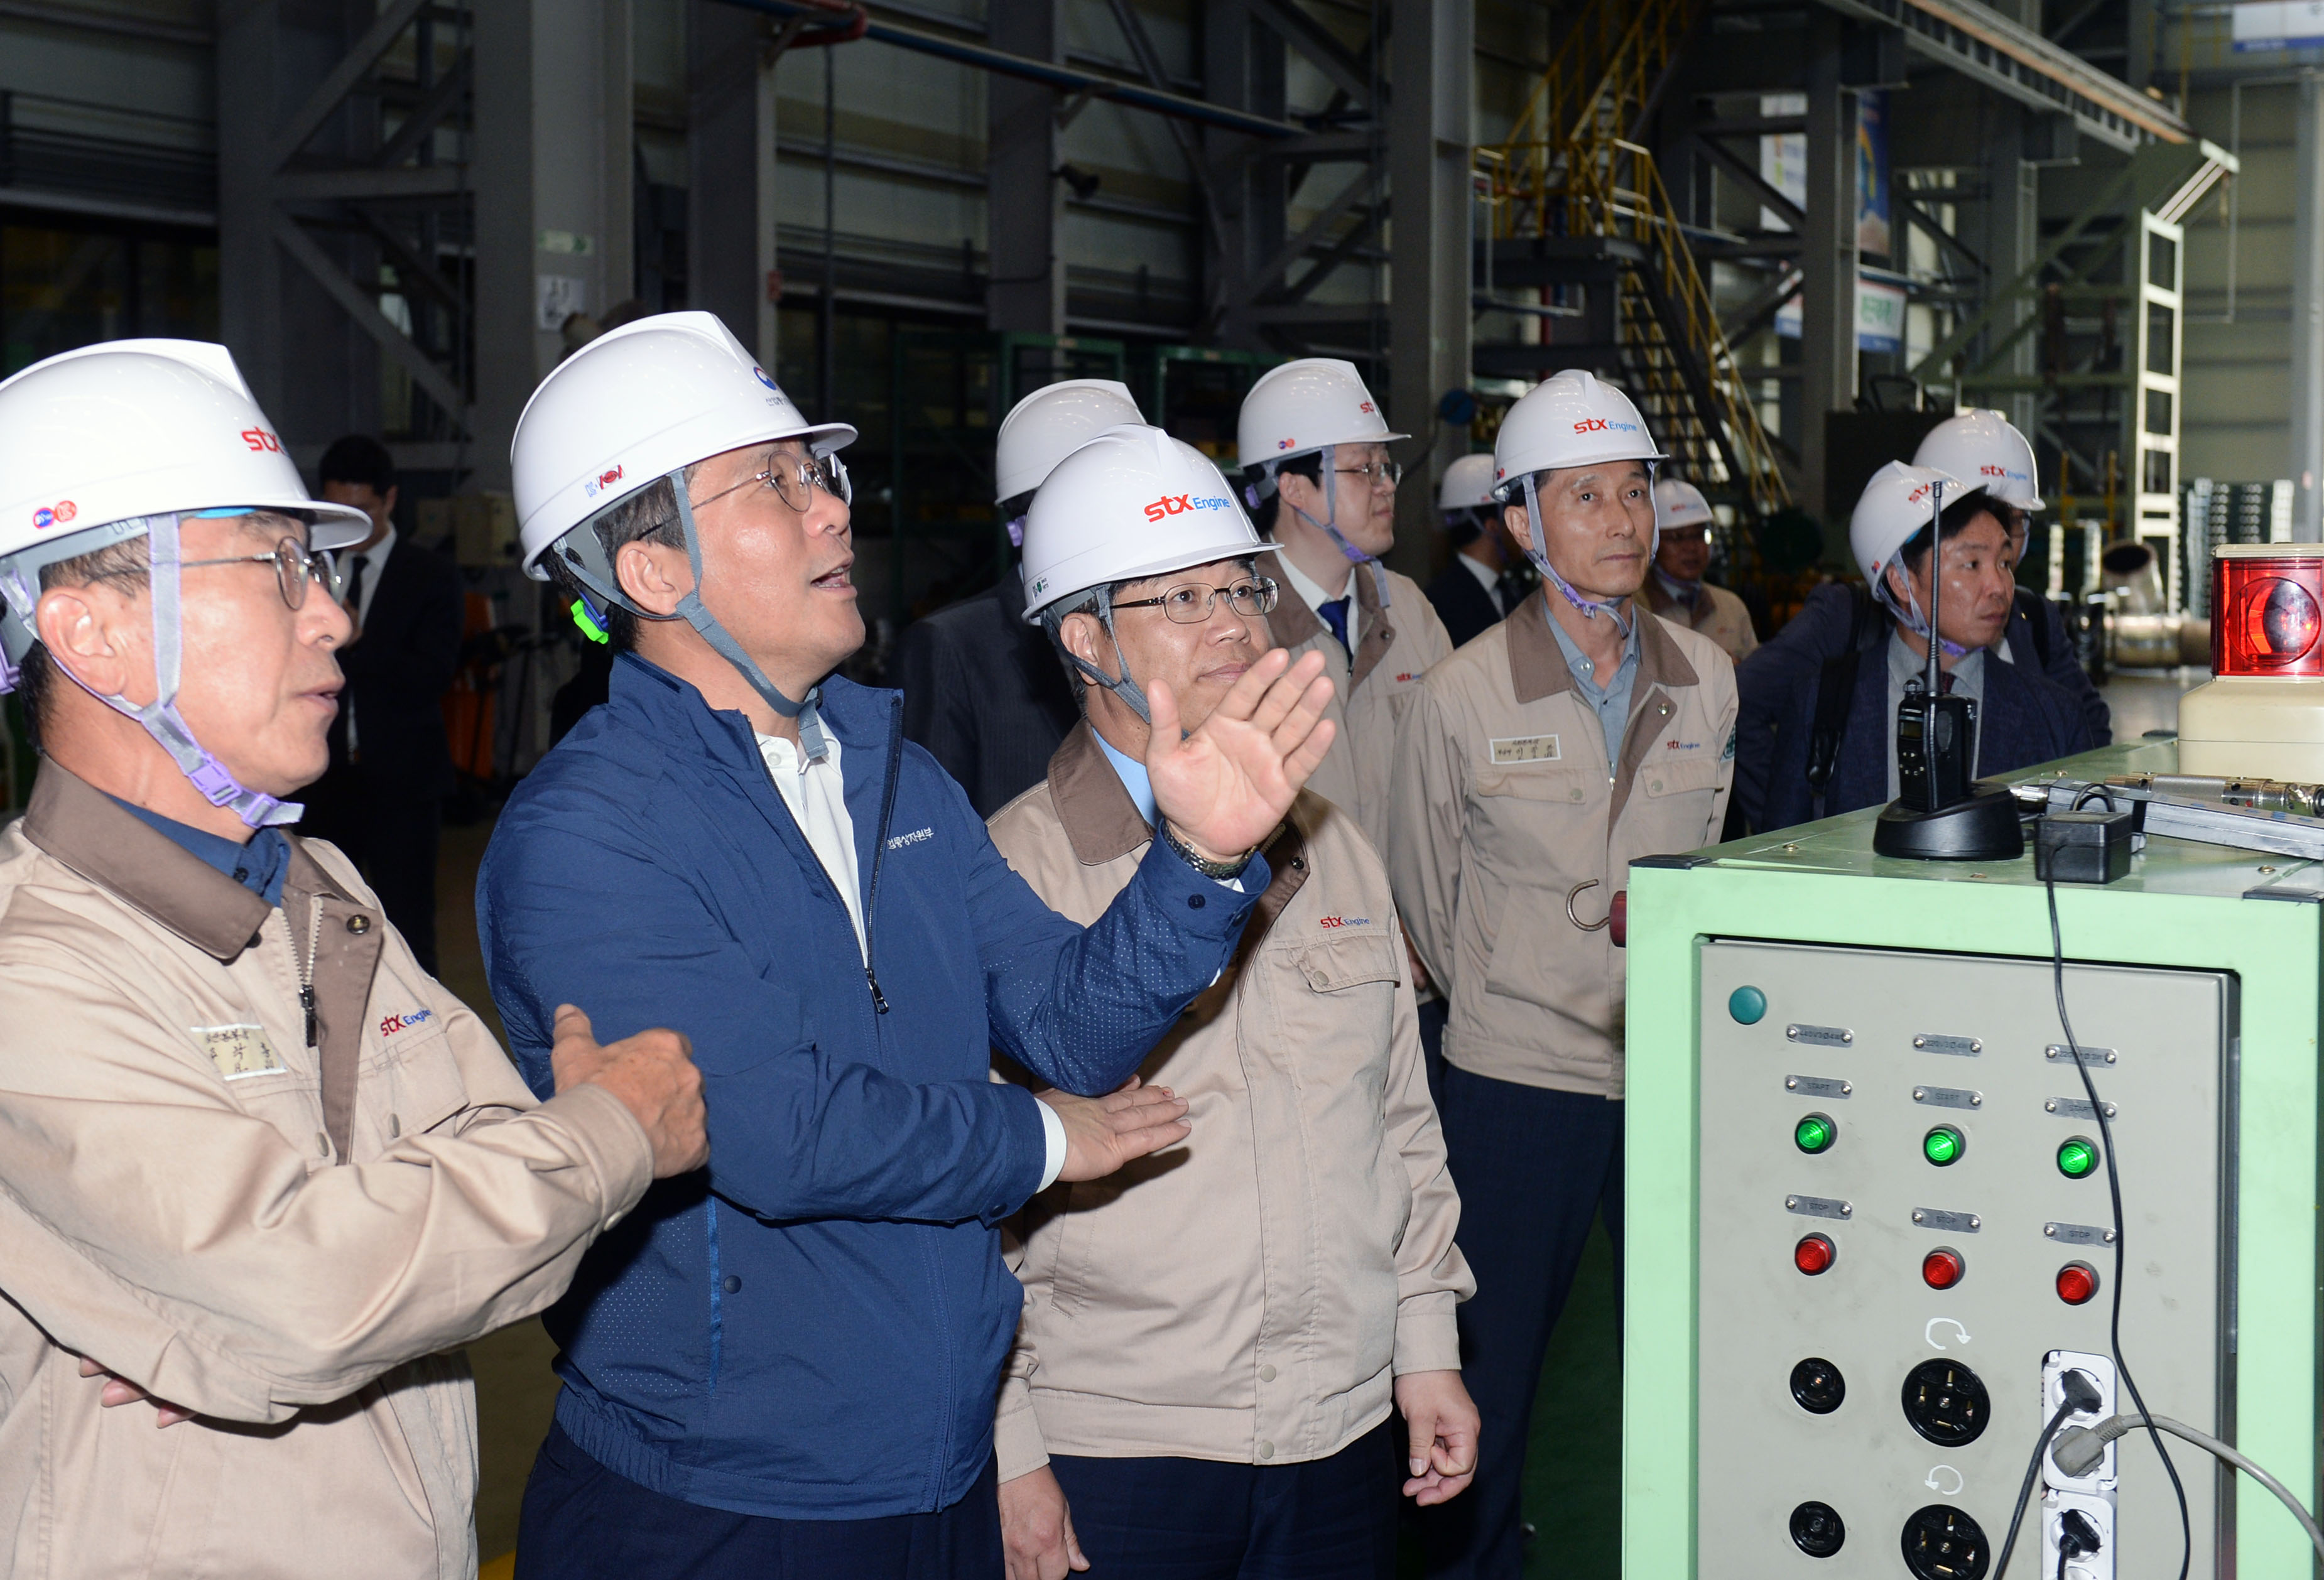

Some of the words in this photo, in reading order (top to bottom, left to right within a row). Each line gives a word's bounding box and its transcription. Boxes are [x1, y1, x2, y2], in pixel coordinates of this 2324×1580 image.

[1573, 418, 1608, 435] stx
[241, 426, 286, 456] stx
[1980, 465, 2005, 478] stx
[1144, 494, 1195, 522] stx
[1192, 495, 1231, 511] Engine
[1667, 740, 1680, 750] stx
[1320, 916, 1345, 928] stx
[1344, 917, 1370, 926] Engine
[380, 1014, 406, 1037] stx
